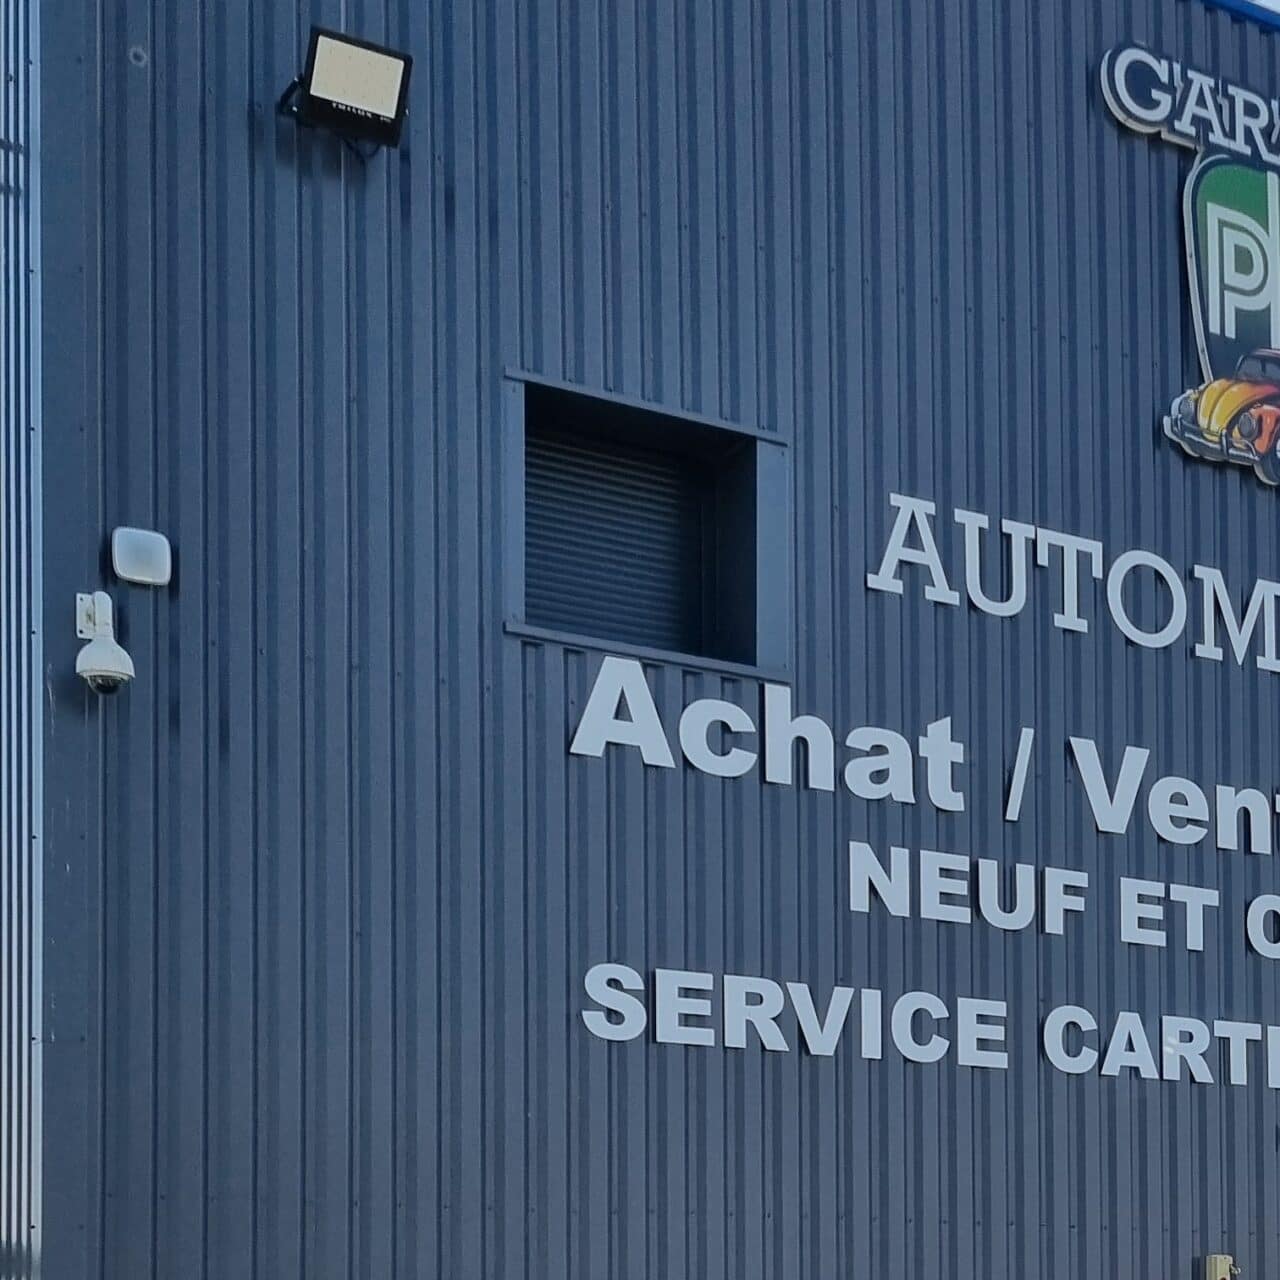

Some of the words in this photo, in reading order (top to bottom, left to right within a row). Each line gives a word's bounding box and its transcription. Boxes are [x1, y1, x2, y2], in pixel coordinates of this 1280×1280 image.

[569, 655, 966, 812] Achat
[1004, 727, 1035, 822] /
[848, 840, 1089, 935] NEUF
[1119, 877, 1220, 952] ET
[581, 962, 1009, 1070] SERVICE
